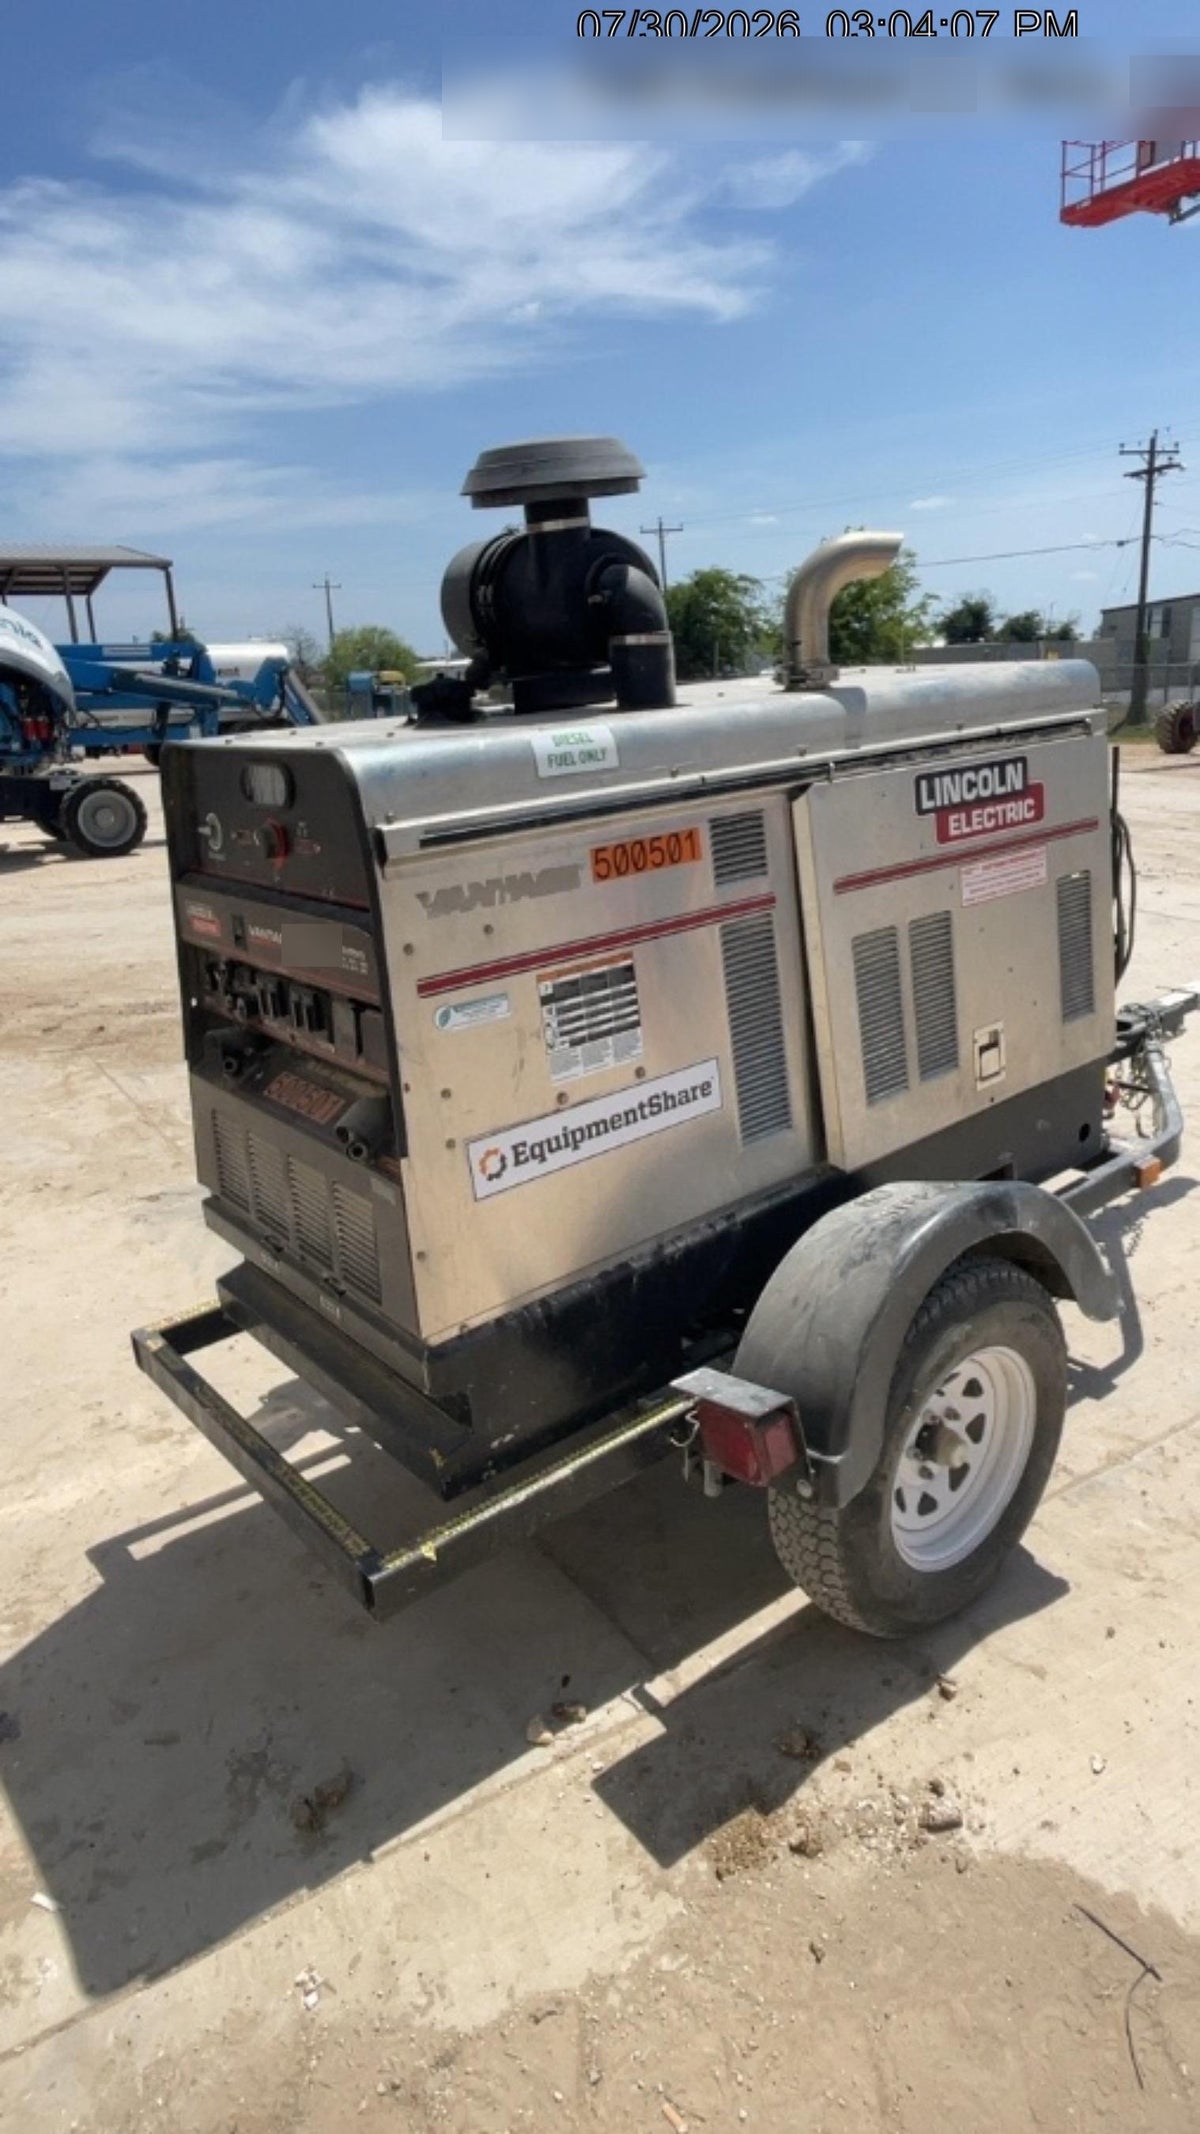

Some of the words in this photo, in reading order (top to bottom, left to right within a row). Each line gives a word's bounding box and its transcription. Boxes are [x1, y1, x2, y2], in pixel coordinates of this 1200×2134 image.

[547, 752, 576, 768] FUEL
[579, 747, 607, 764] ONLY
[920, 762, 1023, 810] LINCOLN
[948, 798, 1035, 836] ELECTRIC
[593, 829, 698, 881] 500501
[511, 1080, 714, 1168] EquipmentShare
